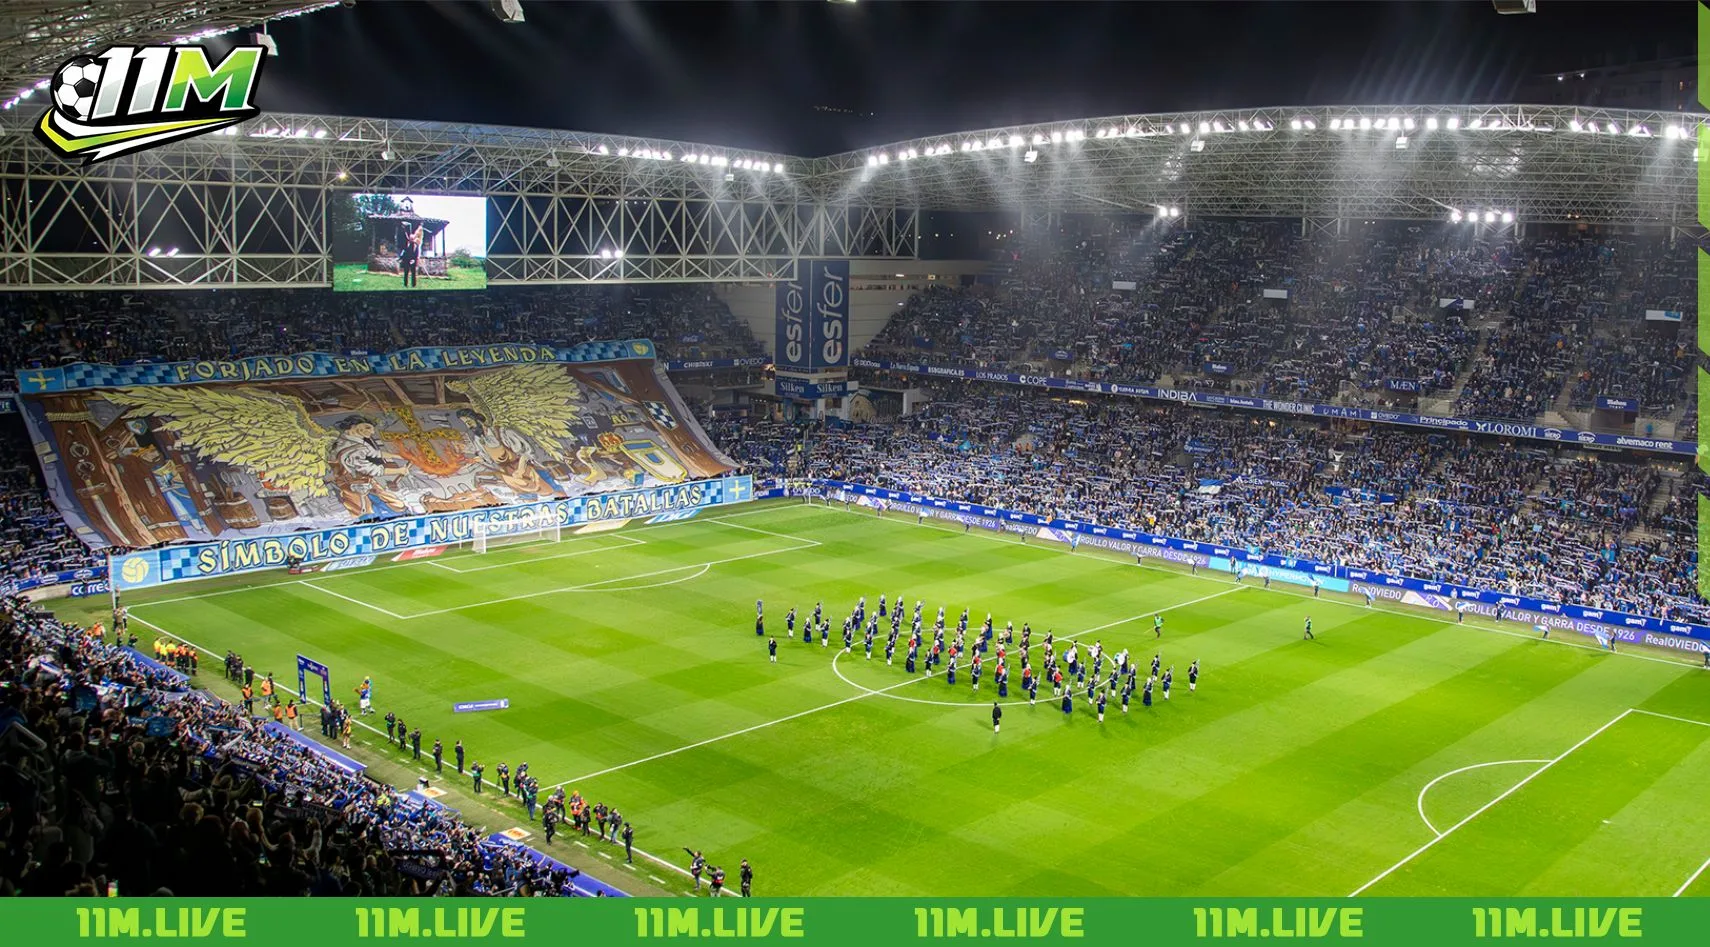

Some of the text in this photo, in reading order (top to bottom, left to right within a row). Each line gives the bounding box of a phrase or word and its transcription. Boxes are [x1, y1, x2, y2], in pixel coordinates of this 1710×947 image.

[817, 266, 843, 364] esfer
[176, 345, 558, 382] FORJADO EN LA LEYENDA
[780, 381, 805, 393] Silken
[816, 383, 843, 393] Silken
[1420, 416, 1468, 425] Principado
[1488, 423, 1536, 437] LOROMI
[1617, 436, 1654, 447] alvemaco
[1655, 440, 1673, 449] rent
[197, 484, 703, 574] SÍMBOLO DE NUESTRAS BATALLAS
[1080, 535, 1107, 546] RGULLO
[1108, 540, 1131, 551] VALOR
[1132, 544, 1137, 552] Y
[1533, 615, 1540, 623] Y
[1541, 616, 1575, 629] GARRA
